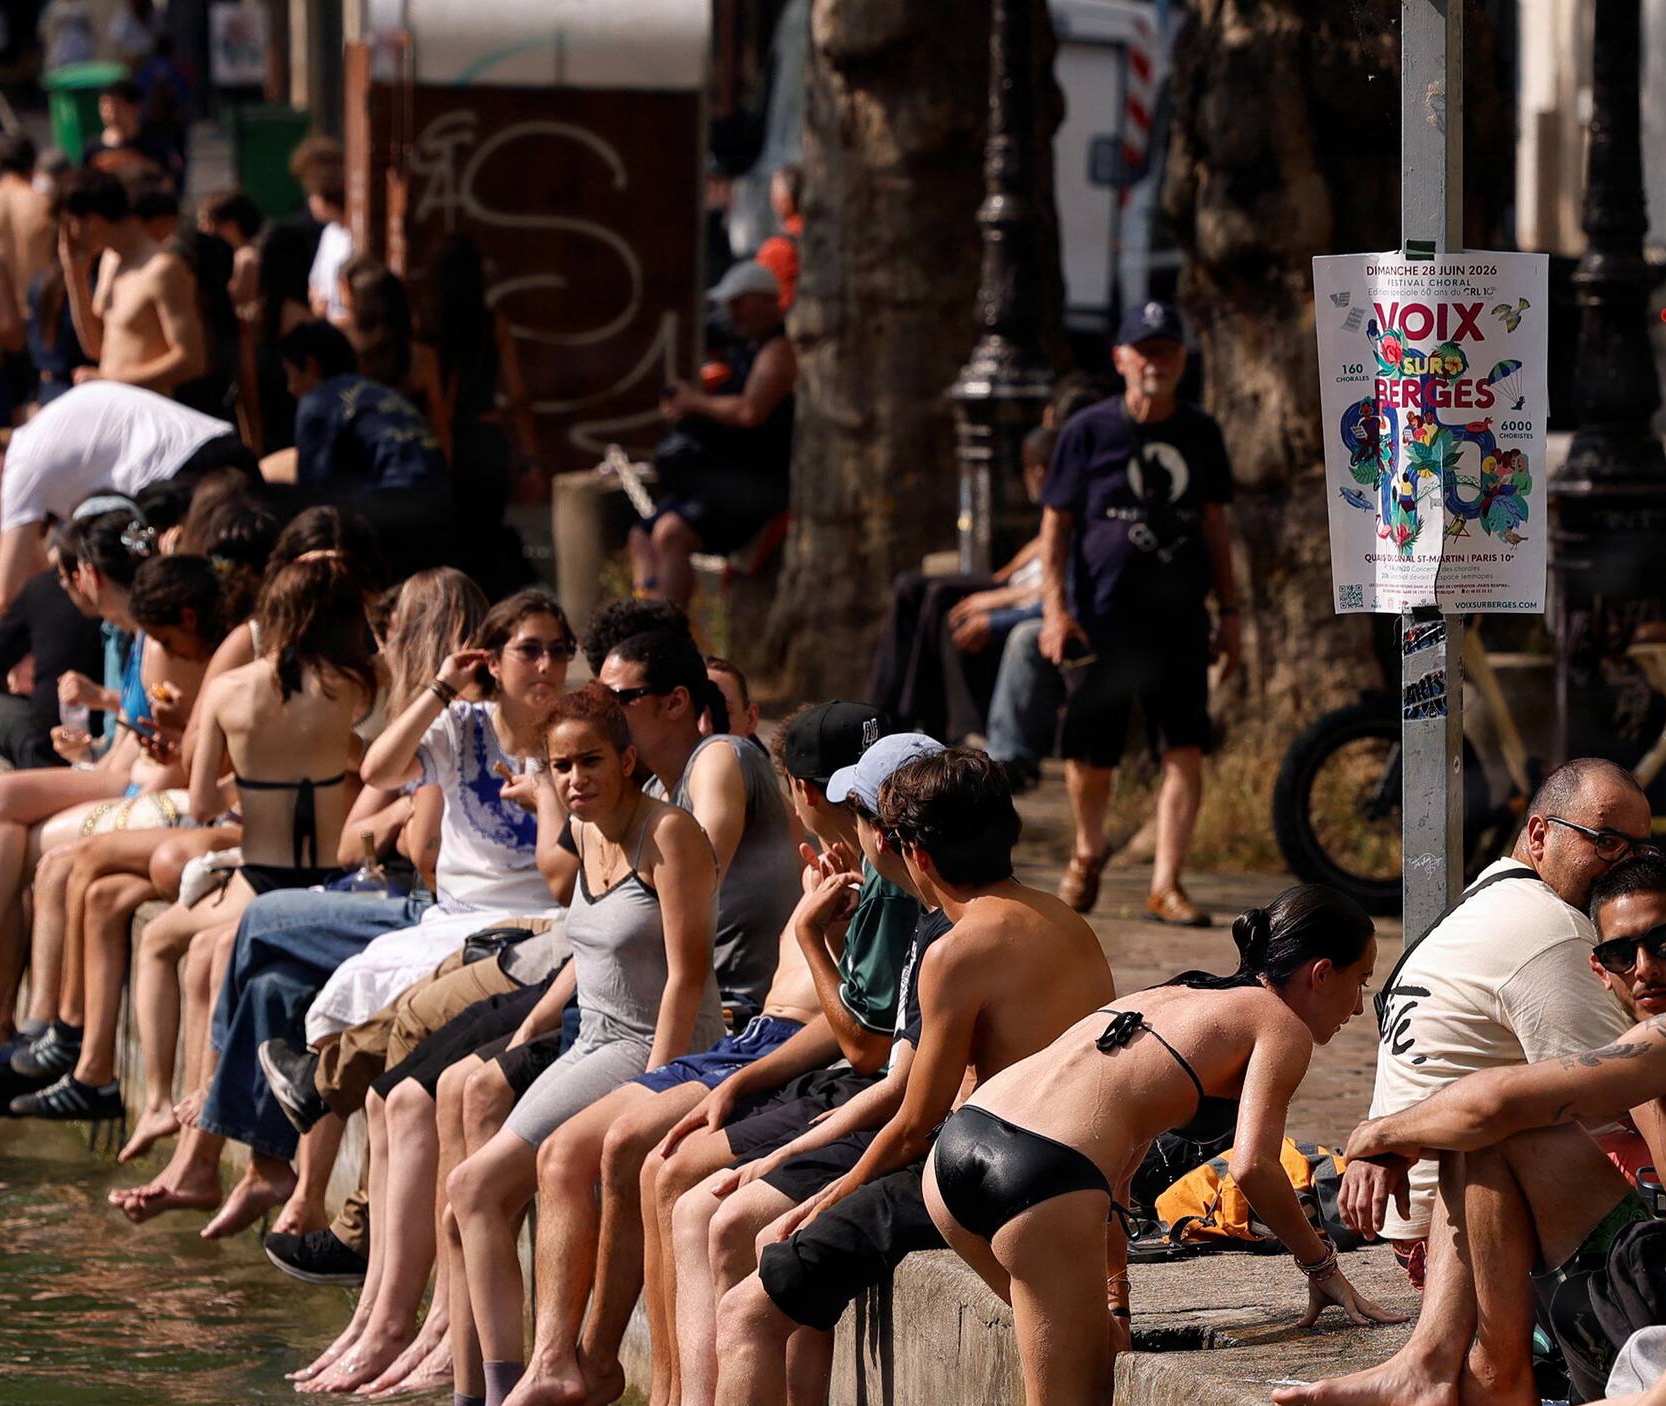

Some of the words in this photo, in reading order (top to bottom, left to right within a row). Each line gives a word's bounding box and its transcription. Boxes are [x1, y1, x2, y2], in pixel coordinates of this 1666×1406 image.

[1366, 266, 1419, 276] DIMANCHE
[1422, 266, 1436, 276] 28
[1439, 265, 1465, 276] JUIN
[1468, 265, 1498, 275] 2026
[1388, 279, 1425, 287] FESTIVAL
[1429, 279, 1471, 287] CHORAL
[1421, 288, 1432, 296] 60
[1450, 288, 1461, 296] du
[1373, 302, 1485, 341] VOIX
[1342, 364, 1363, 374] 160
[1403, 357, 1443, 375] SUR
[1336, 375, 1370, 383] CHORALES
[1374, 378, 1495, 409] BERGES
[1501, 420, 1532, 431] 6000
[1364, 553, 1386, 563] QUAIS
[1417, 554, 1465, 563] ST-MARTIN
[1471, 554, 1497, 562] PARIS
[1455, 601, 1537, 609] VOIXSURBERGES.COM
